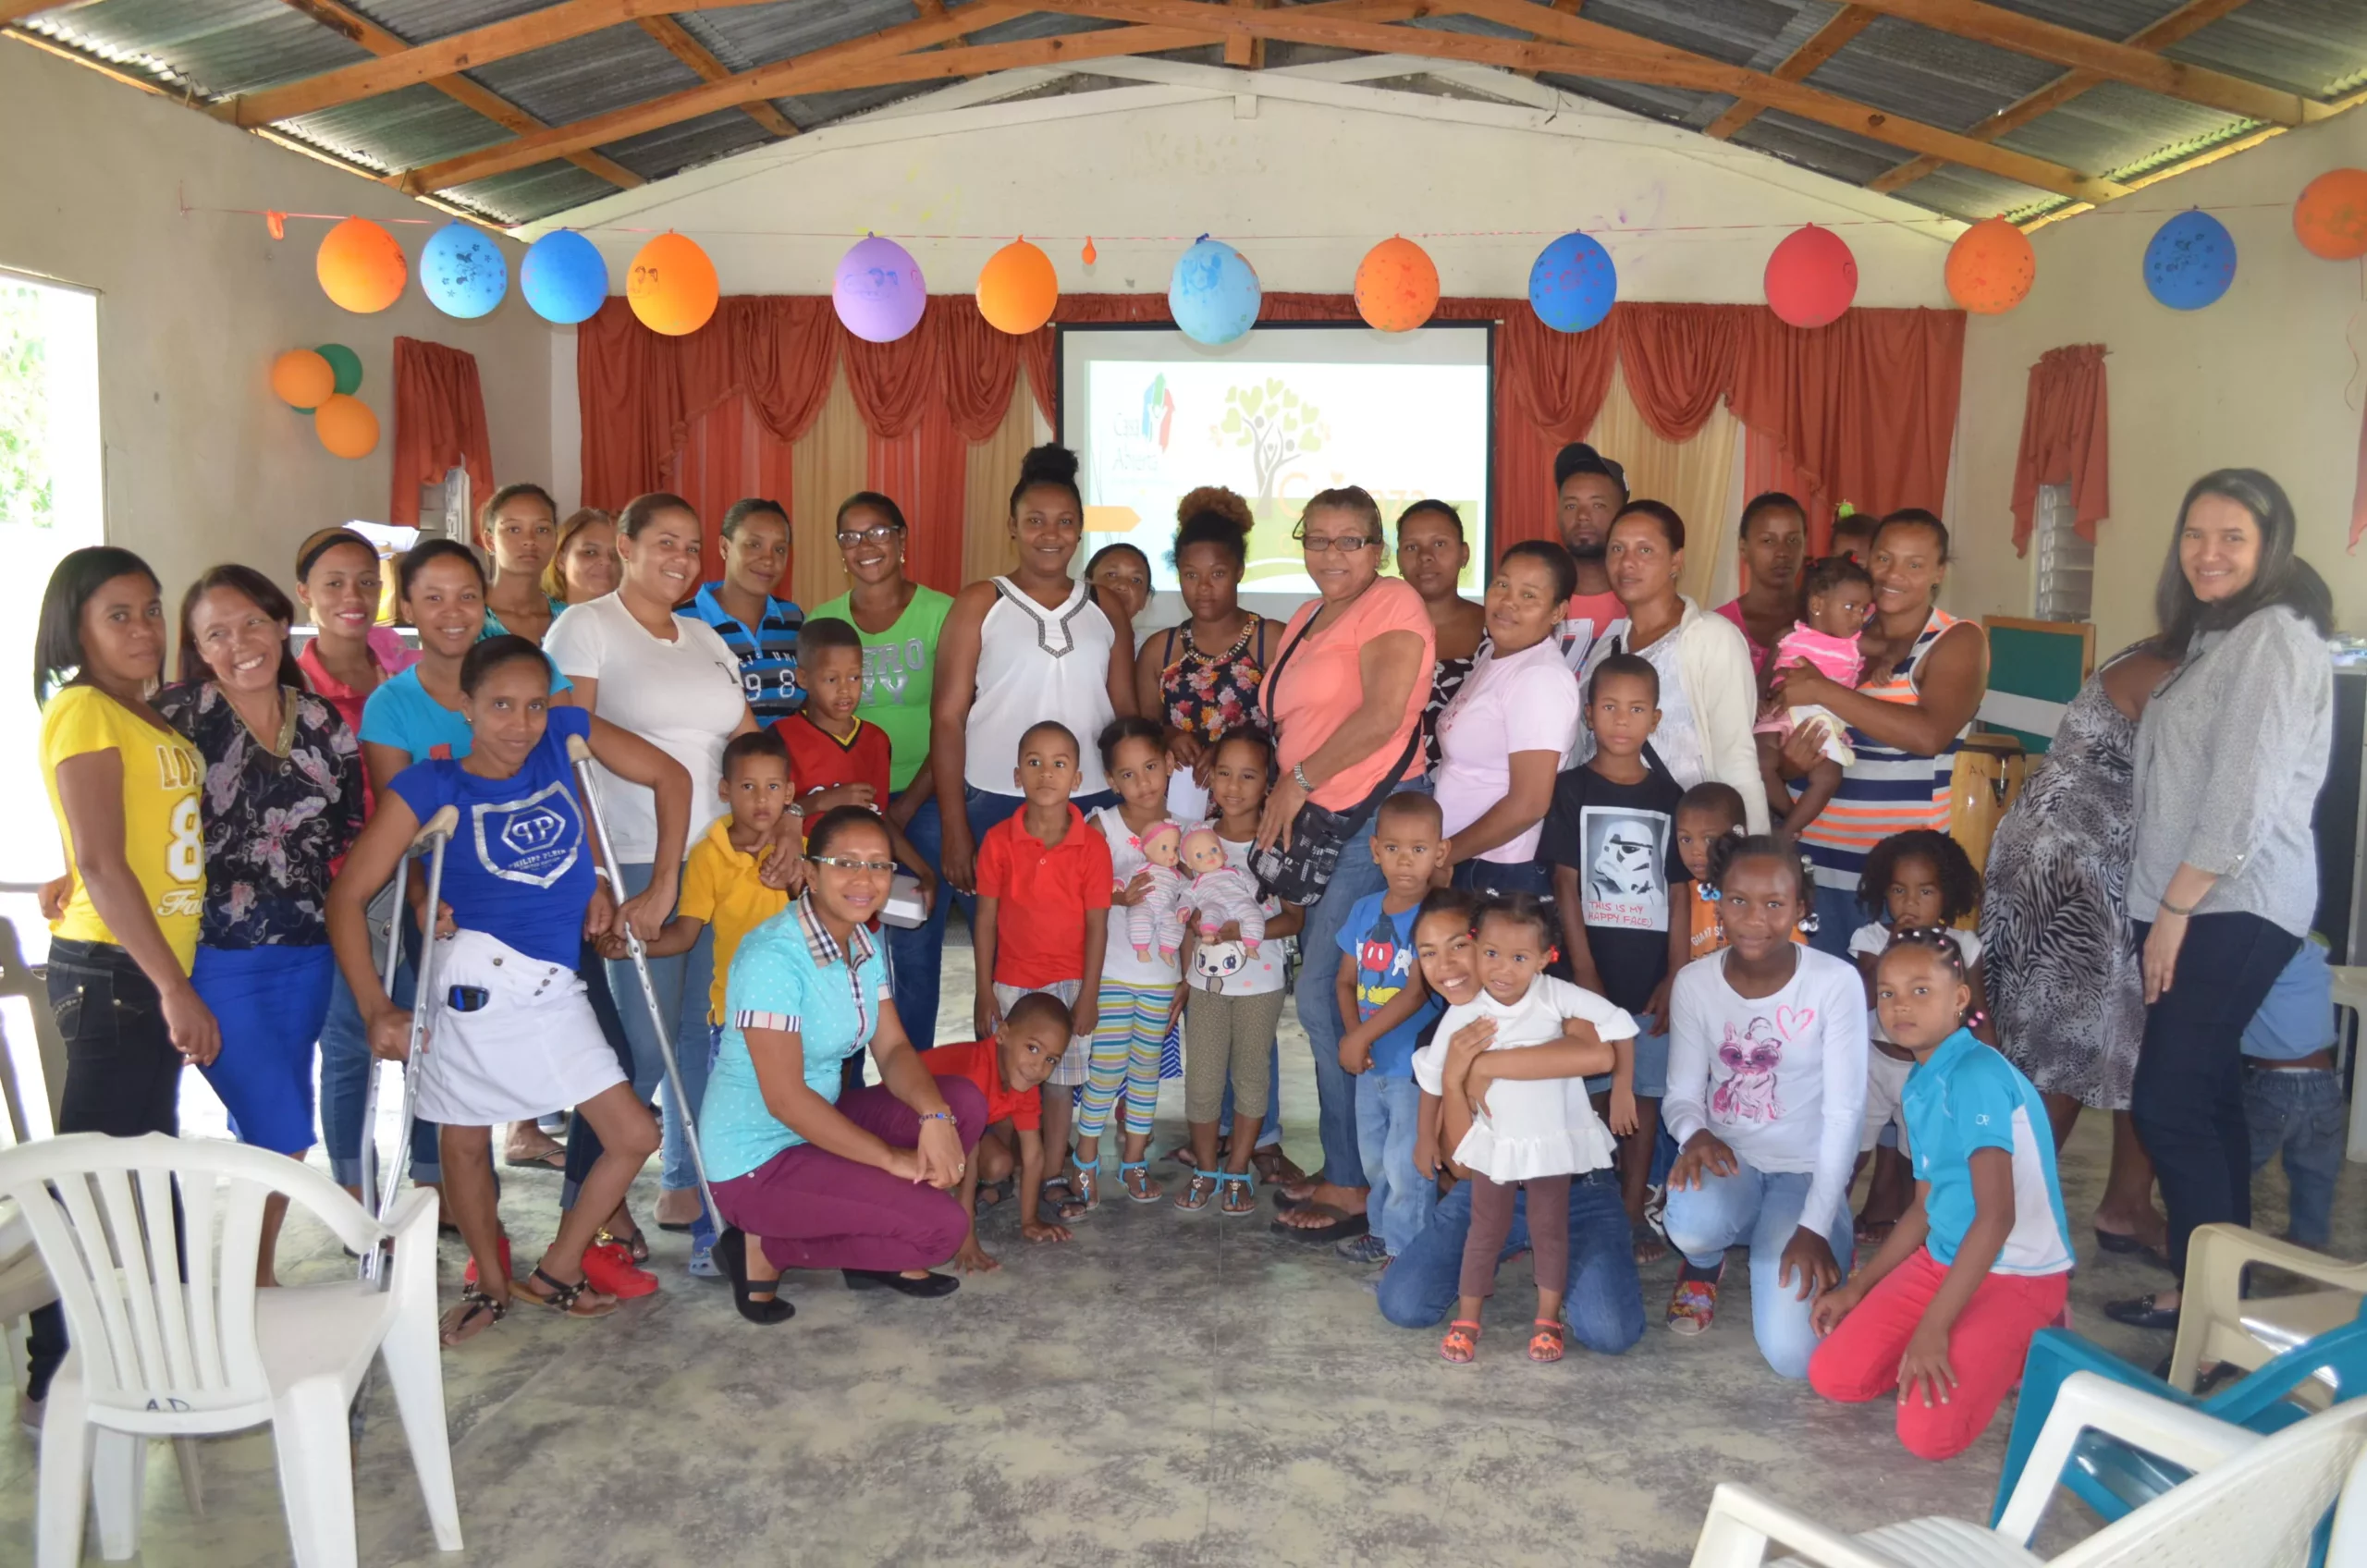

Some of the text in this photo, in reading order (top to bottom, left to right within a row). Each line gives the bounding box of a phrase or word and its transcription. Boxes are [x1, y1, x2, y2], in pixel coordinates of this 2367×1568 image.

[1589, 900, 1643, 915] THIS IS MY
[1588, 912, 1619, 924] HAPPY
